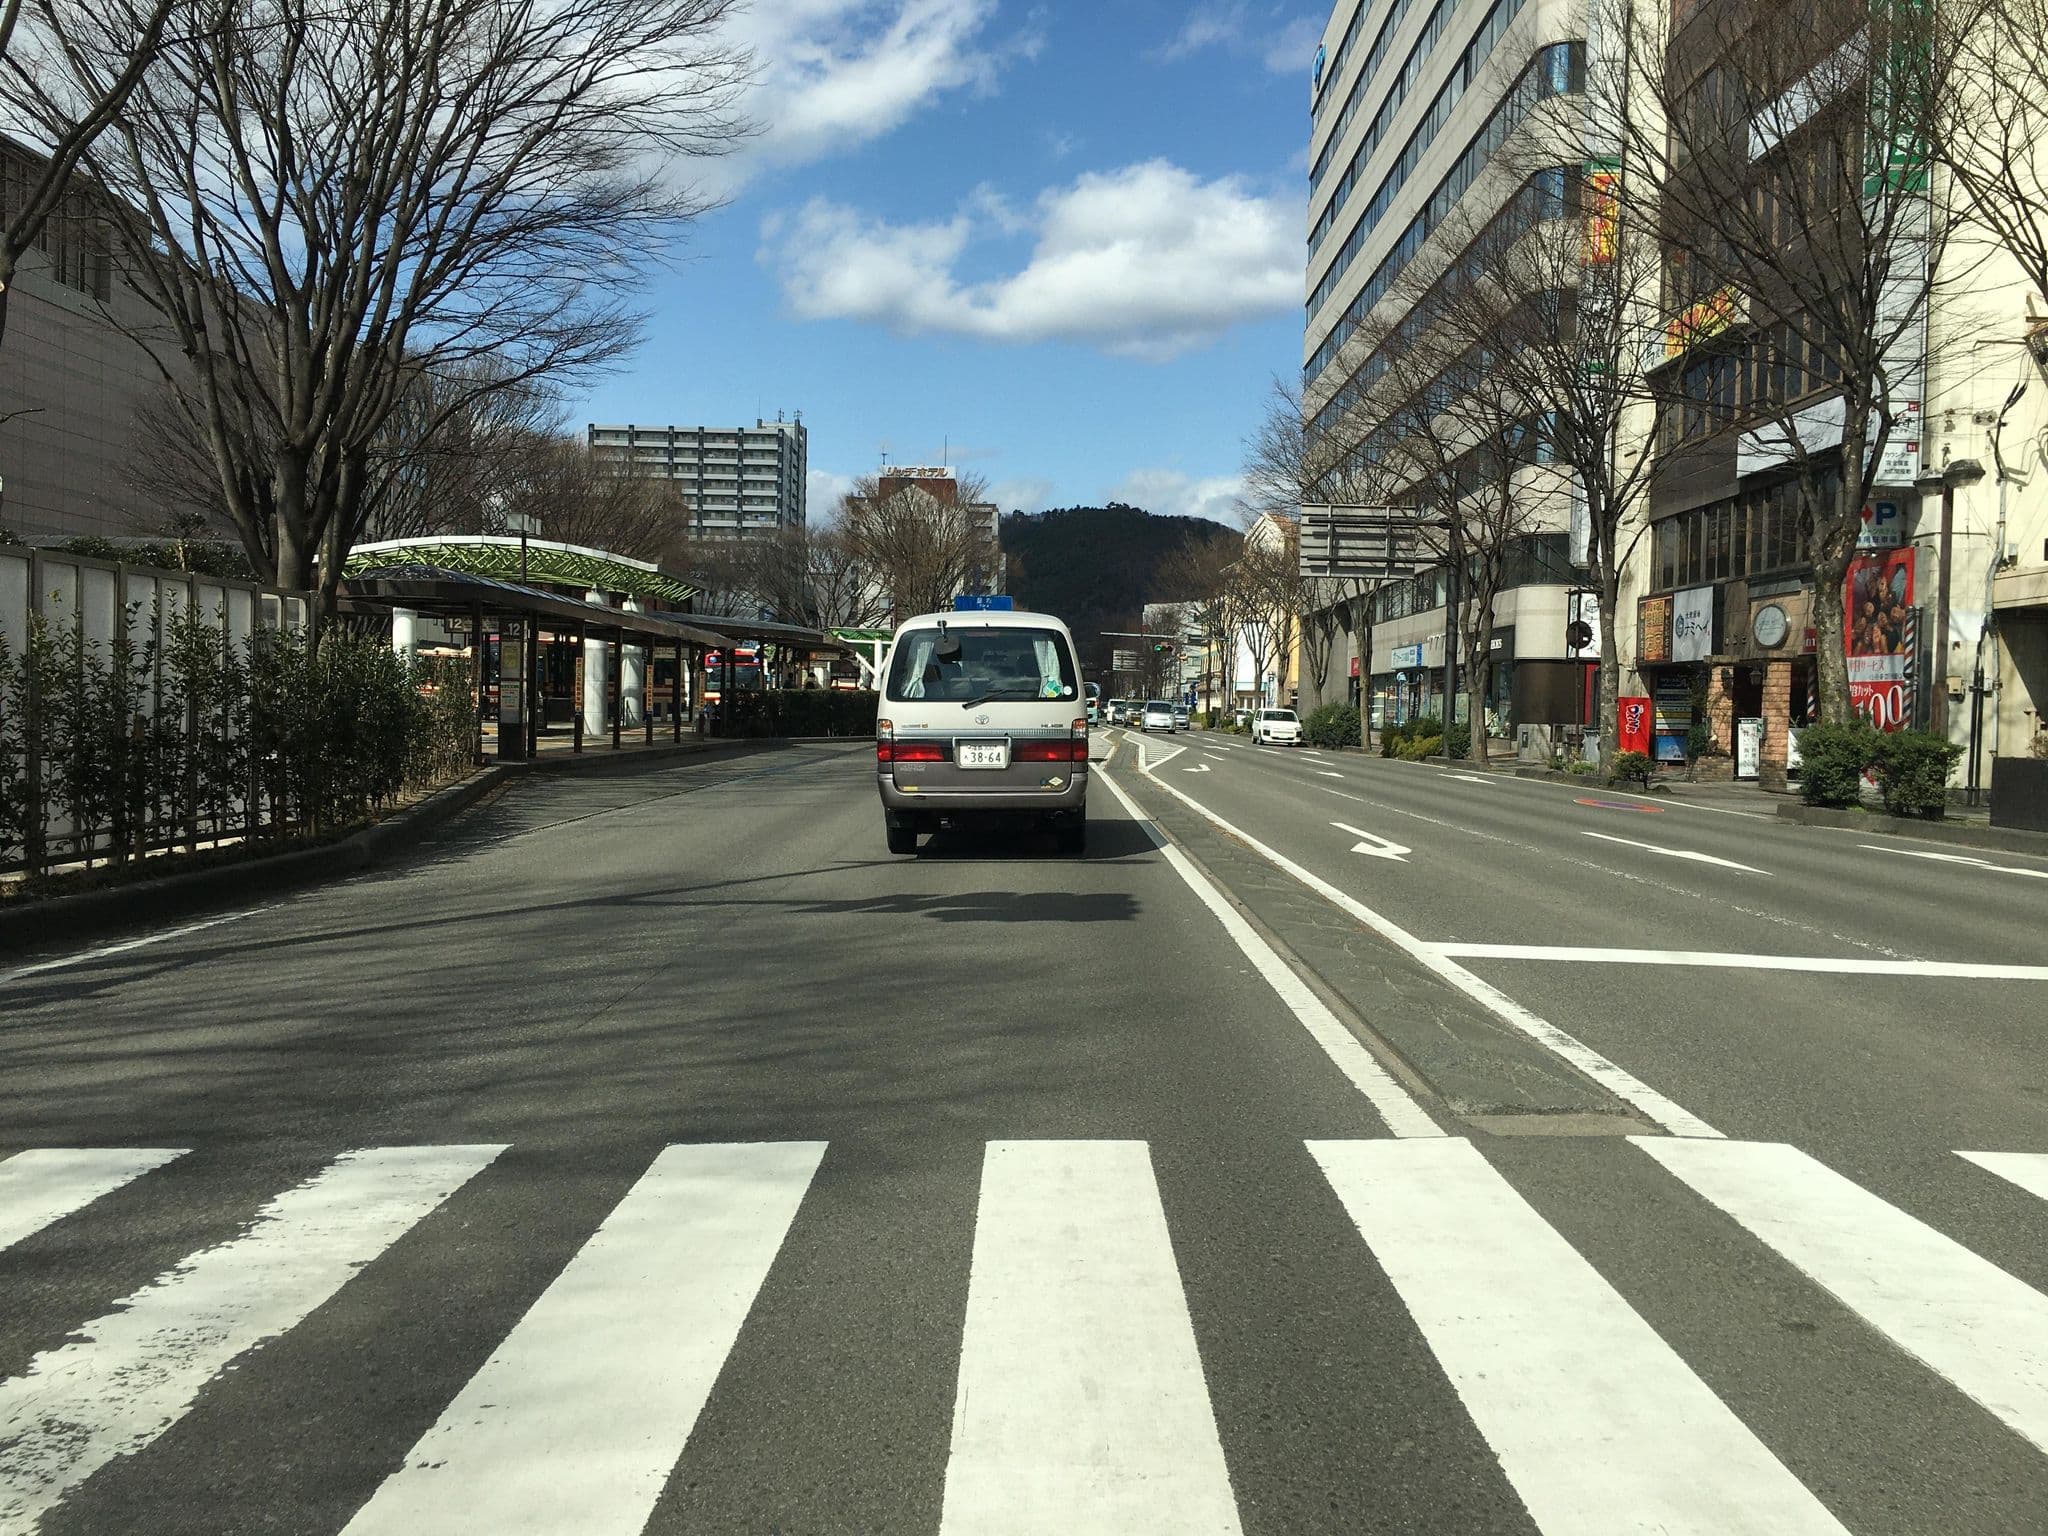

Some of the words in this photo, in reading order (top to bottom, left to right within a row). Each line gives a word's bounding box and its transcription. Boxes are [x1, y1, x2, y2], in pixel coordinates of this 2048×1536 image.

[886, 466, 949, 478] リッチホテル
[1875, 502, 1897, 525] P
[448, 618, 462, 629] 12
[508, 623, 521, 636] 12
